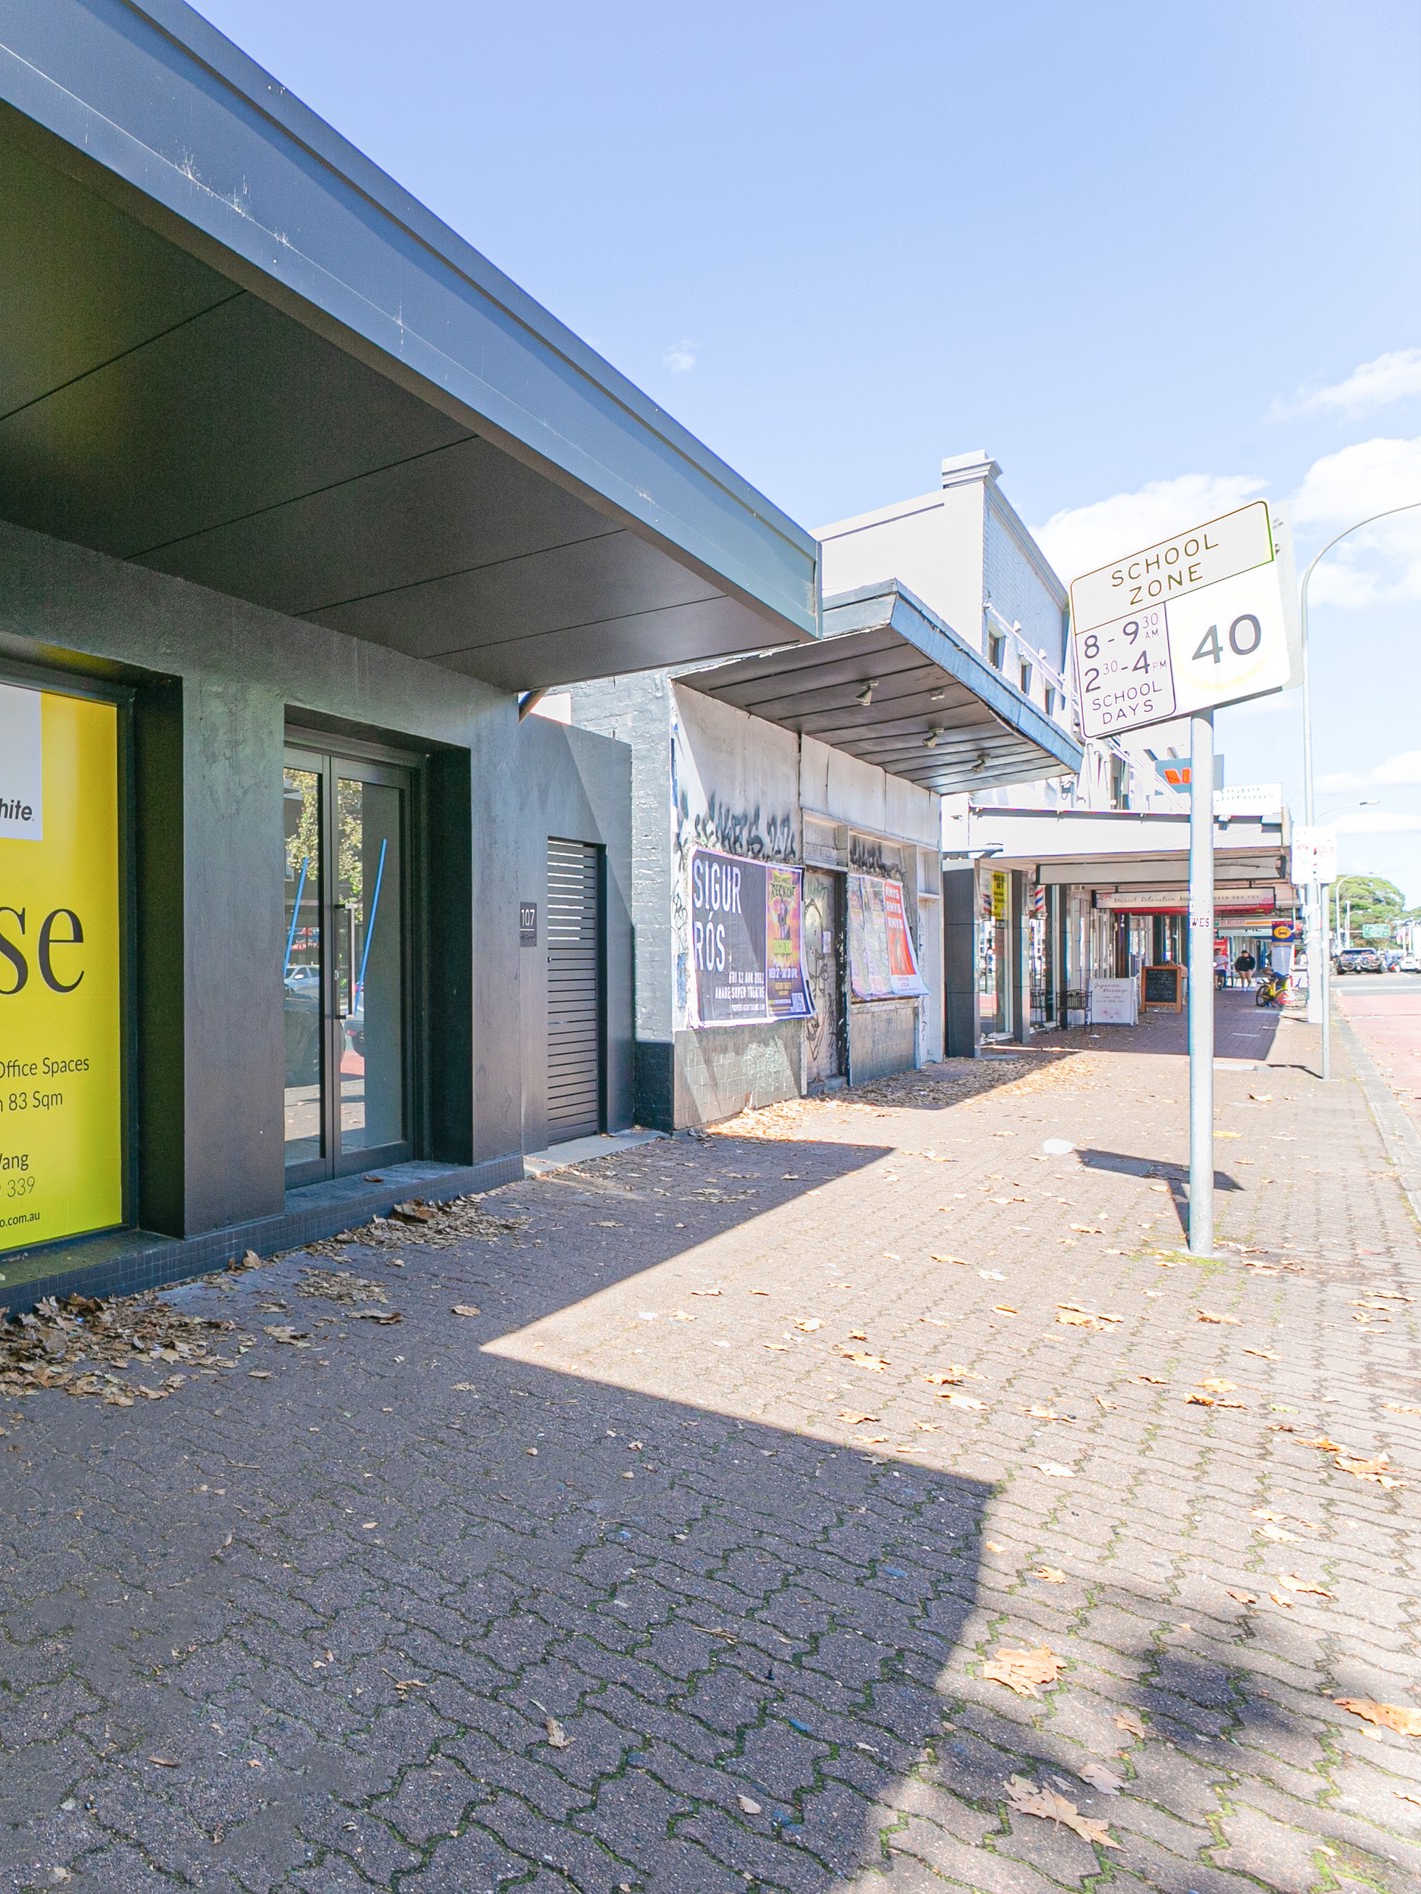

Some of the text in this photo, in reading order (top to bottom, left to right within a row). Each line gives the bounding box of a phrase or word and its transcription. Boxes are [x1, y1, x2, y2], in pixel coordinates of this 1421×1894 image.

[1111, 533, 1220, 588] SCHOOL
[1129, 562, 1204, 606] ZONE
[1144, 628, 1160, 641] AM
[1191, 613, 1263, 665] 40
[1152, 659, 1168, 672] PM
[1091, 680, 1164, 711] SCHOOL
[1102, 699, 1155, 725] DAYS
[693, 858, 742, 914] SIGUR
[521, 909, 535, 926] 107
[694, 909, 726, 972] RÓS
[42, 1056, 90, 1078] Spaces
[8, 1091, 28, 1112] 83
[32, 1090, 64, 1111] Sqm
[6, 1175, 36, 1198] 339
